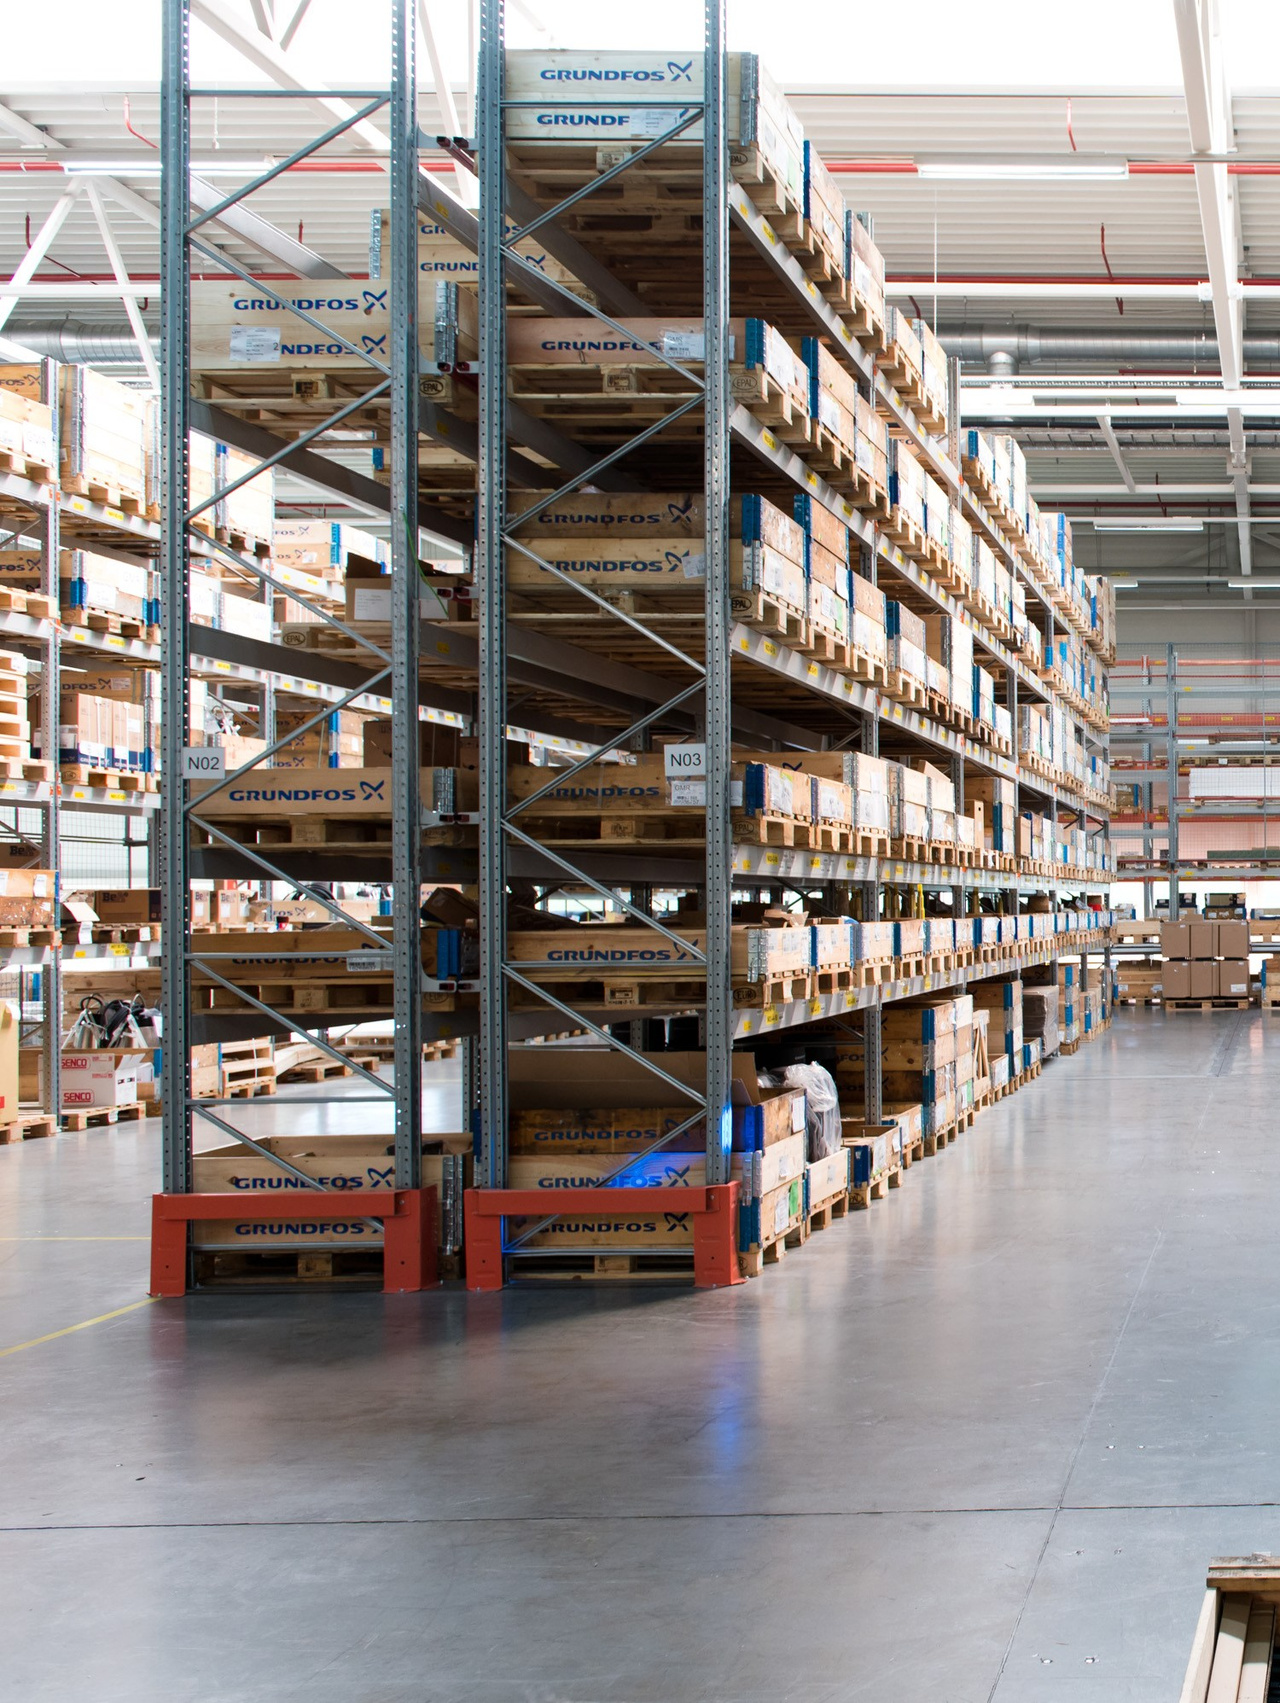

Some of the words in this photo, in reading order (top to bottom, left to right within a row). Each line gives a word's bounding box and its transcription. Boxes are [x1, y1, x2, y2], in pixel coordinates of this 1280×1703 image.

[540, 69, 665, 81] GRUNDFOS
[537, 114, 630, 126] GRUNDF
[281, 343, 358, 355] NDFOS
[423, 382, 441, 392] EPAL
[736, 379, 754, 388] EPAL
[538, 514, 661, 524] GRUNDFOS
[286, 634, 303, 643] EPAL
[188, 757, 220, 770] N02
[670, 753, 702, 767] N03
[229, 790, 356, 801] GRUNDFOS
[734, 823, 752, 832] EPAL
[547, 950, 671, 961] GRUNDFOS
[61, 1058, 87, 1067] SENCO
[63, 1092, 91, 1101] SENCO
[534, 1129, 657, 1141] GRUNDFOS
[235, 1223, 364, 1235] GRUNDFOS
